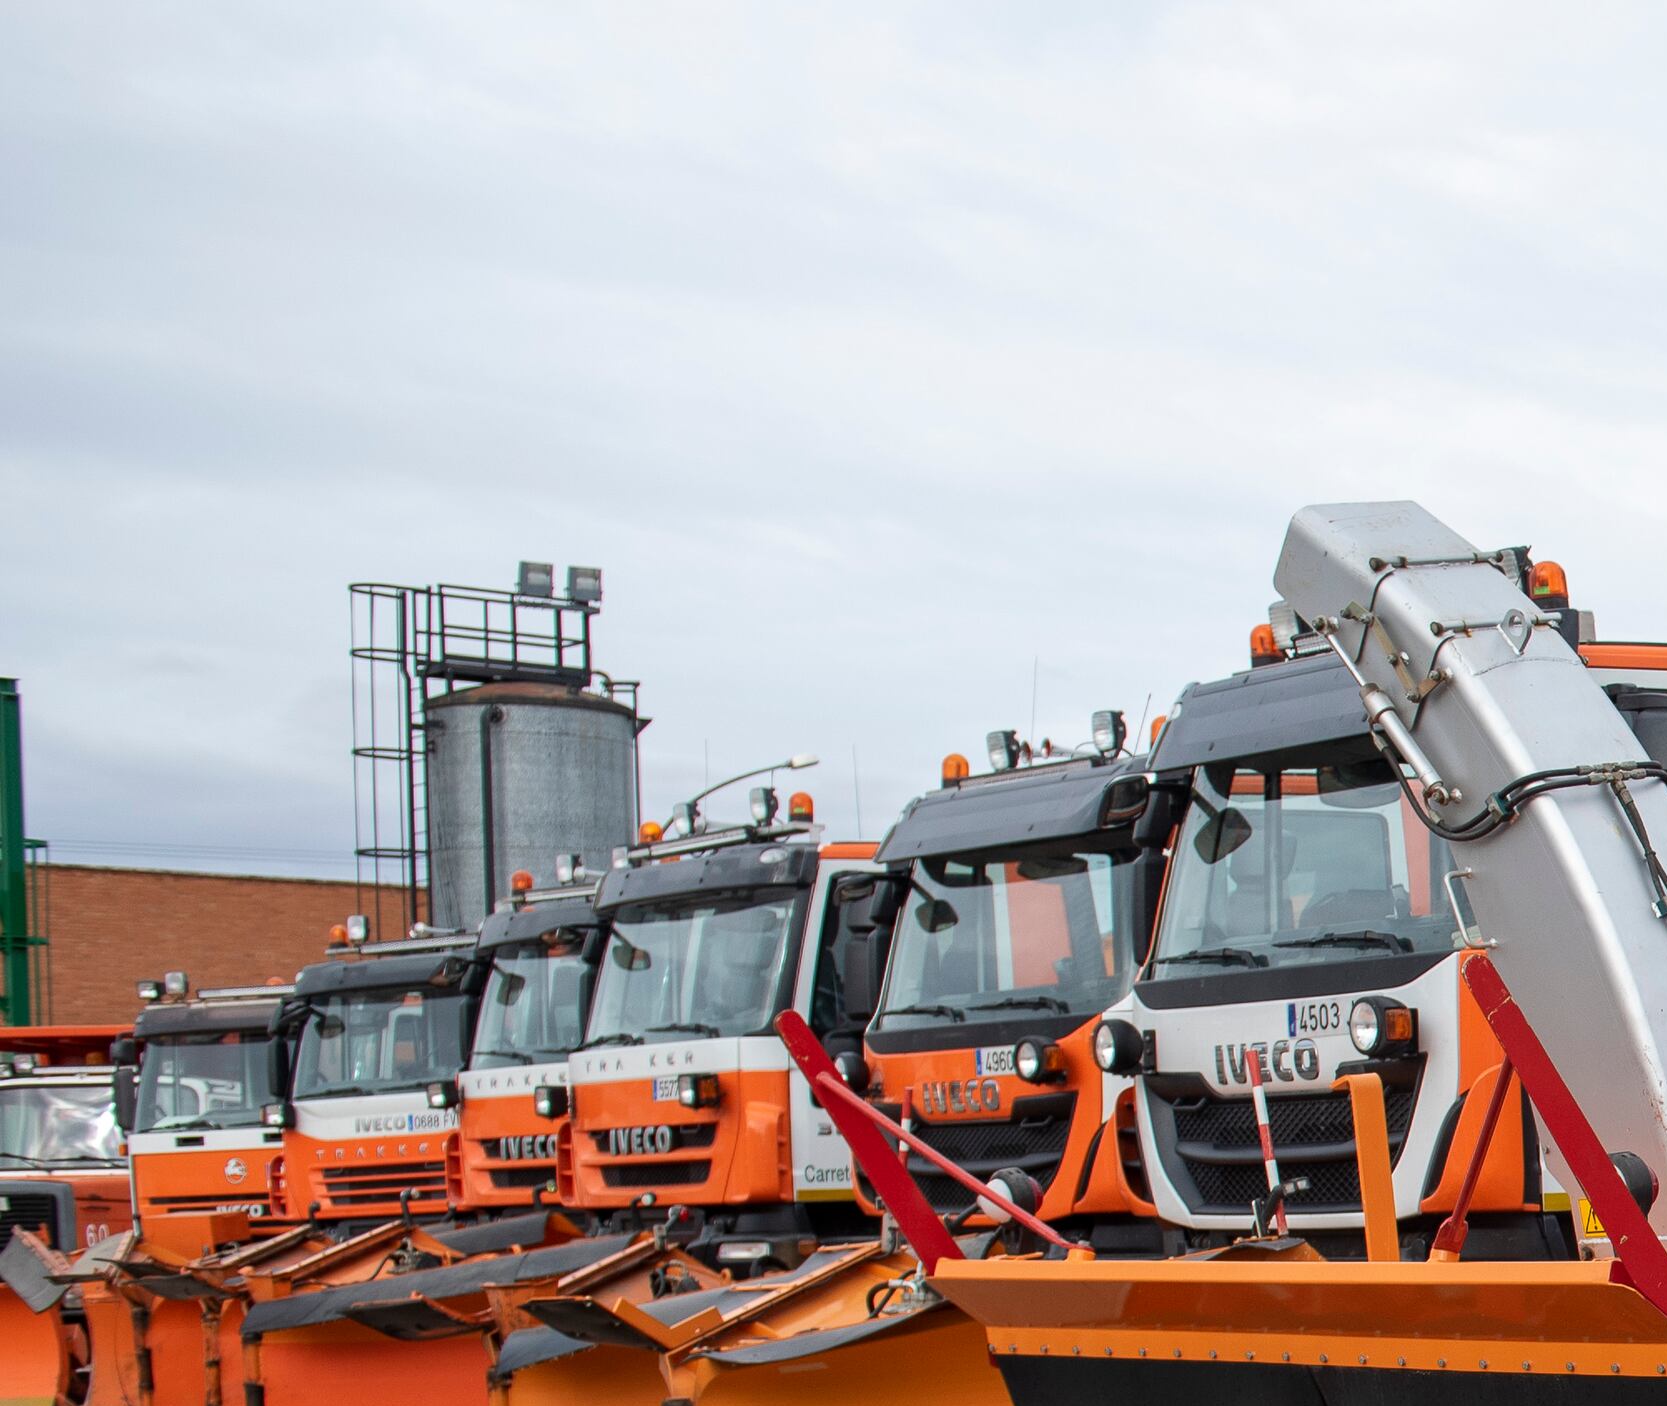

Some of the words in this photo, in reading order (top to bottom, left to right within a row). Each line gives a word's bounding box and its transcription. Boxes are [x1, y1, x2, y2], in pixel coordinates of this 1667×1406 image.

[1299, 1002, 1340, 1032] 4503
[1215, 1038, 1320, 1085] IVECO
[923, 1079, 1000, 1114] IVECO
[354, 1118, 406, 1133] IVECO
[609, 1125, 672, 1156] IVECO
[500, 1134, 558, 1161] IVECO
[85, 1223, 111, 1248] 60
